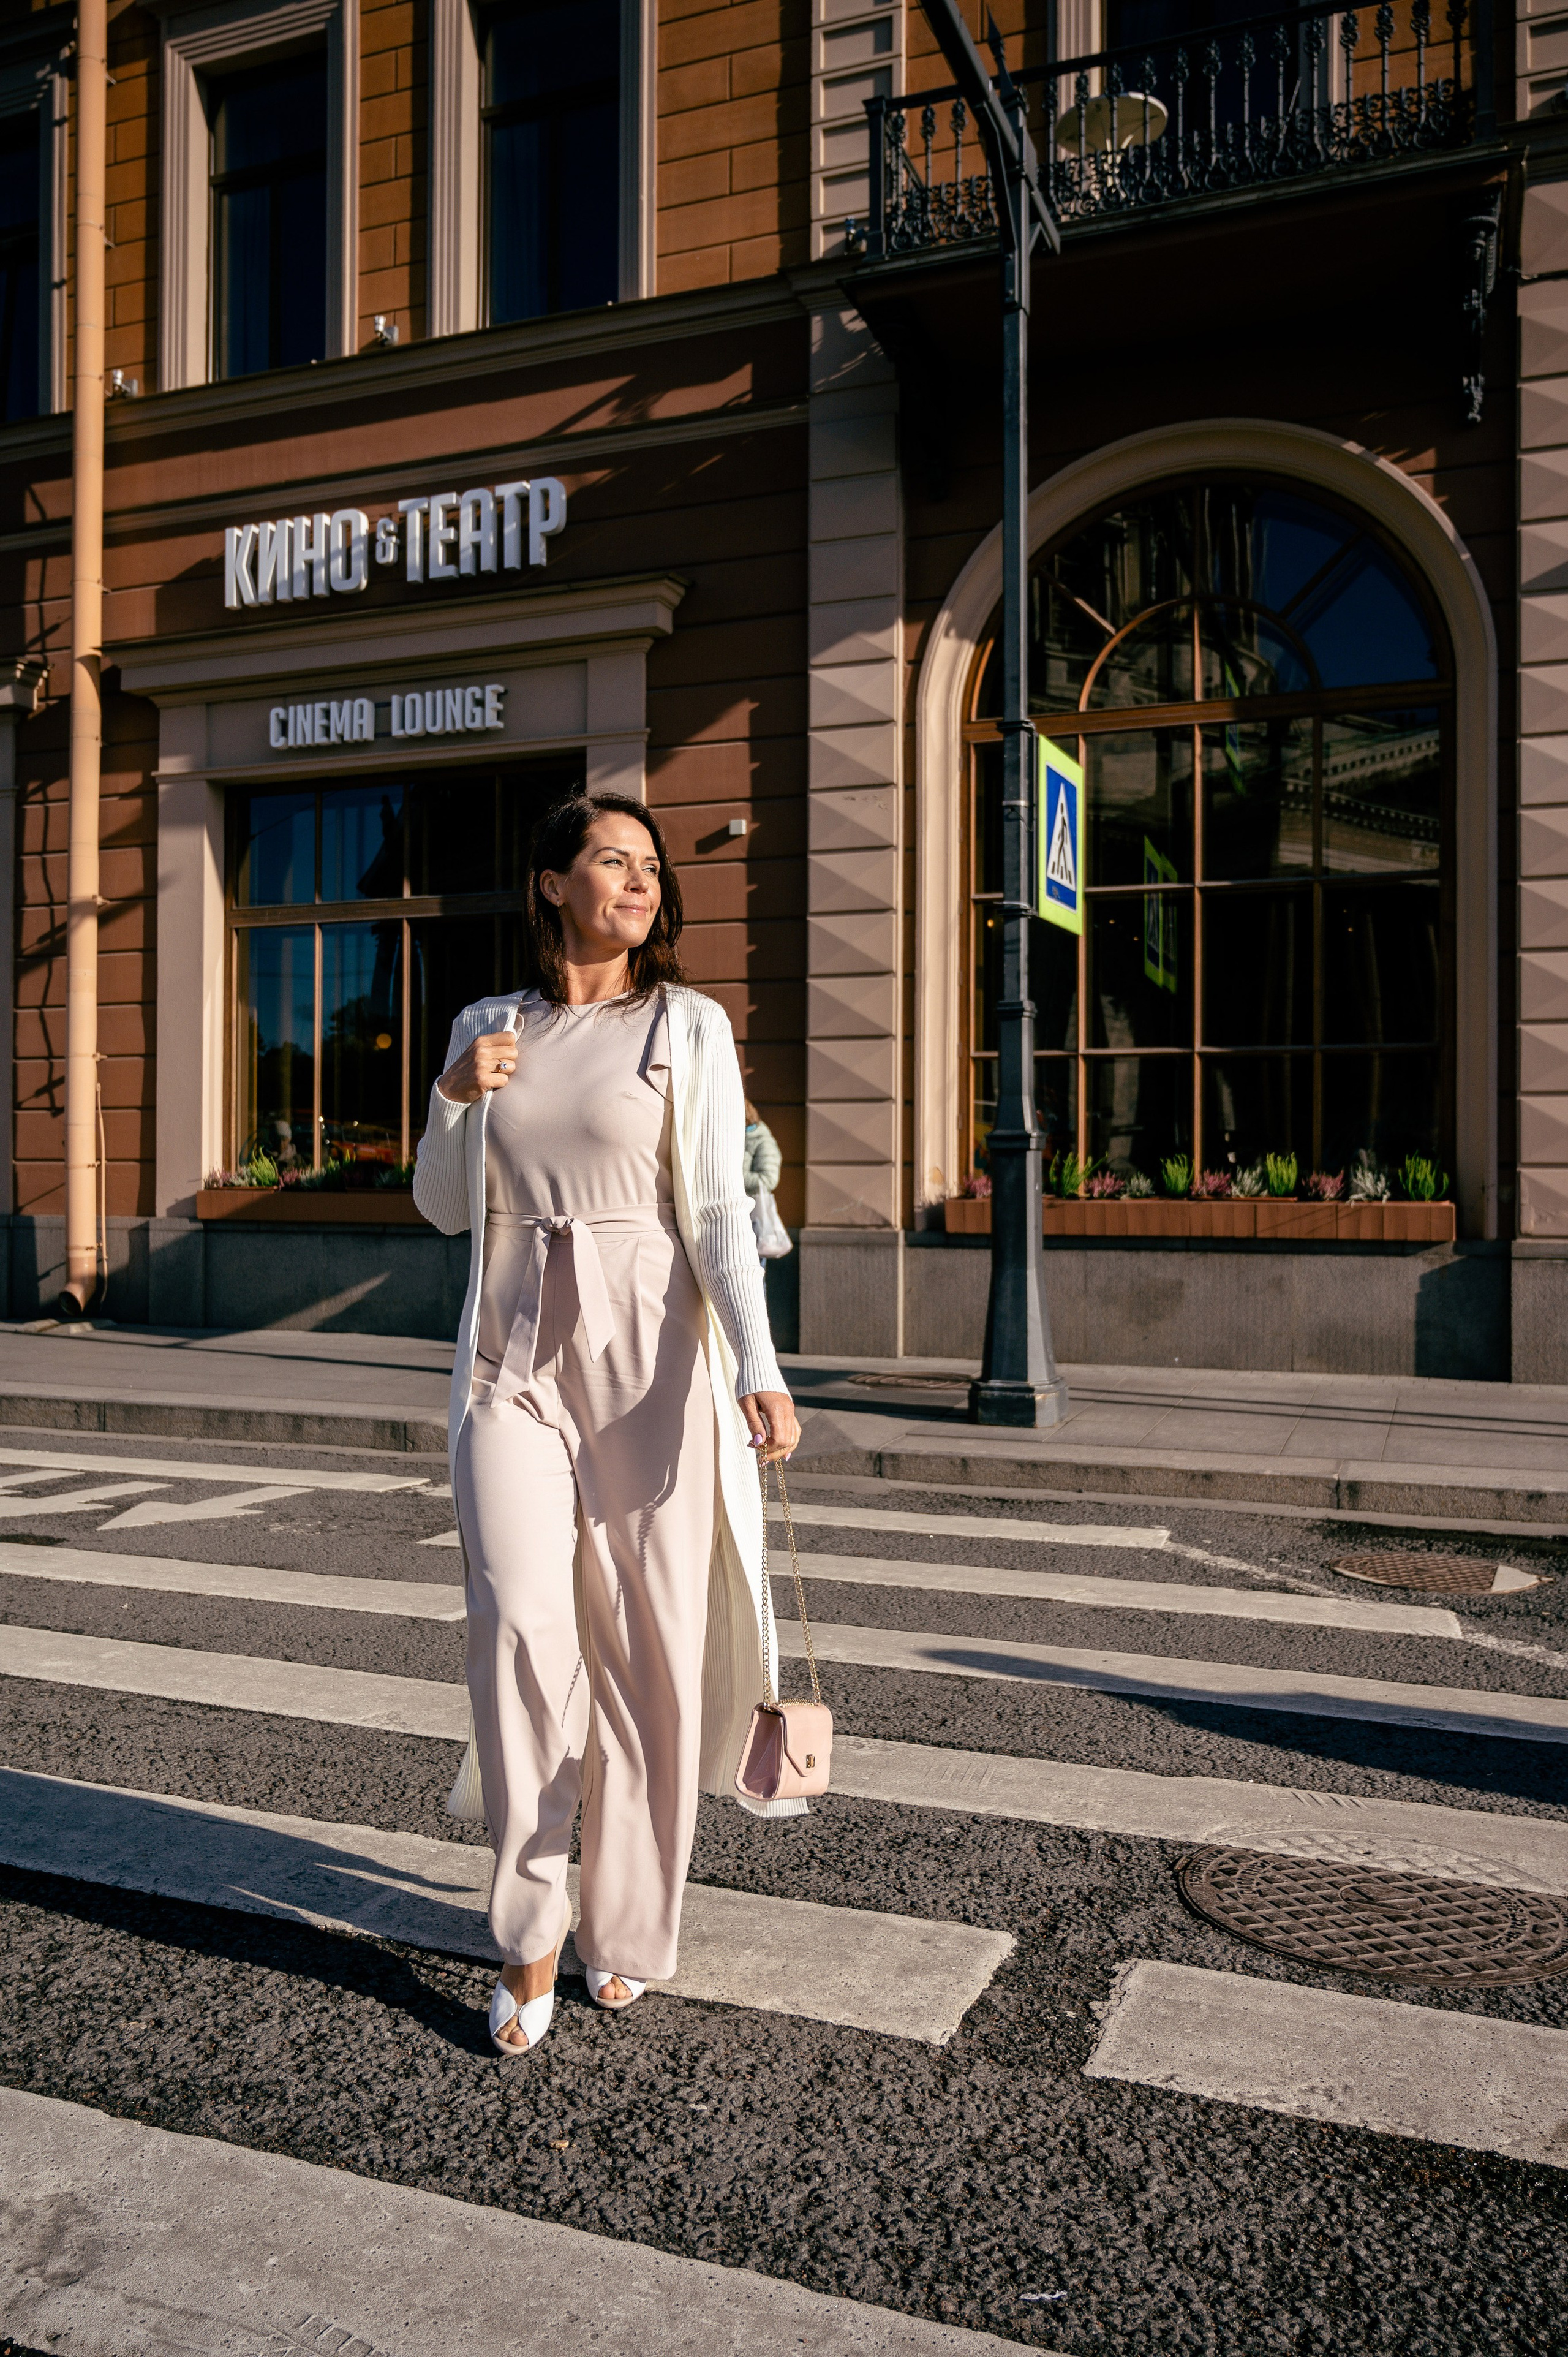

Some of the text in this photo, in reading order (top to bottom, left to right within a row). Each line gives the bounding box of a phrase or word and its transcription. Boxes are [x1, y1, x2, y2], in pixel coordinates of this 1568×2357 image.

[224, 477, 567, 610] КИНО & ТЕАТР
[270, 684, 505, 750] CINEMA LOUNGE
